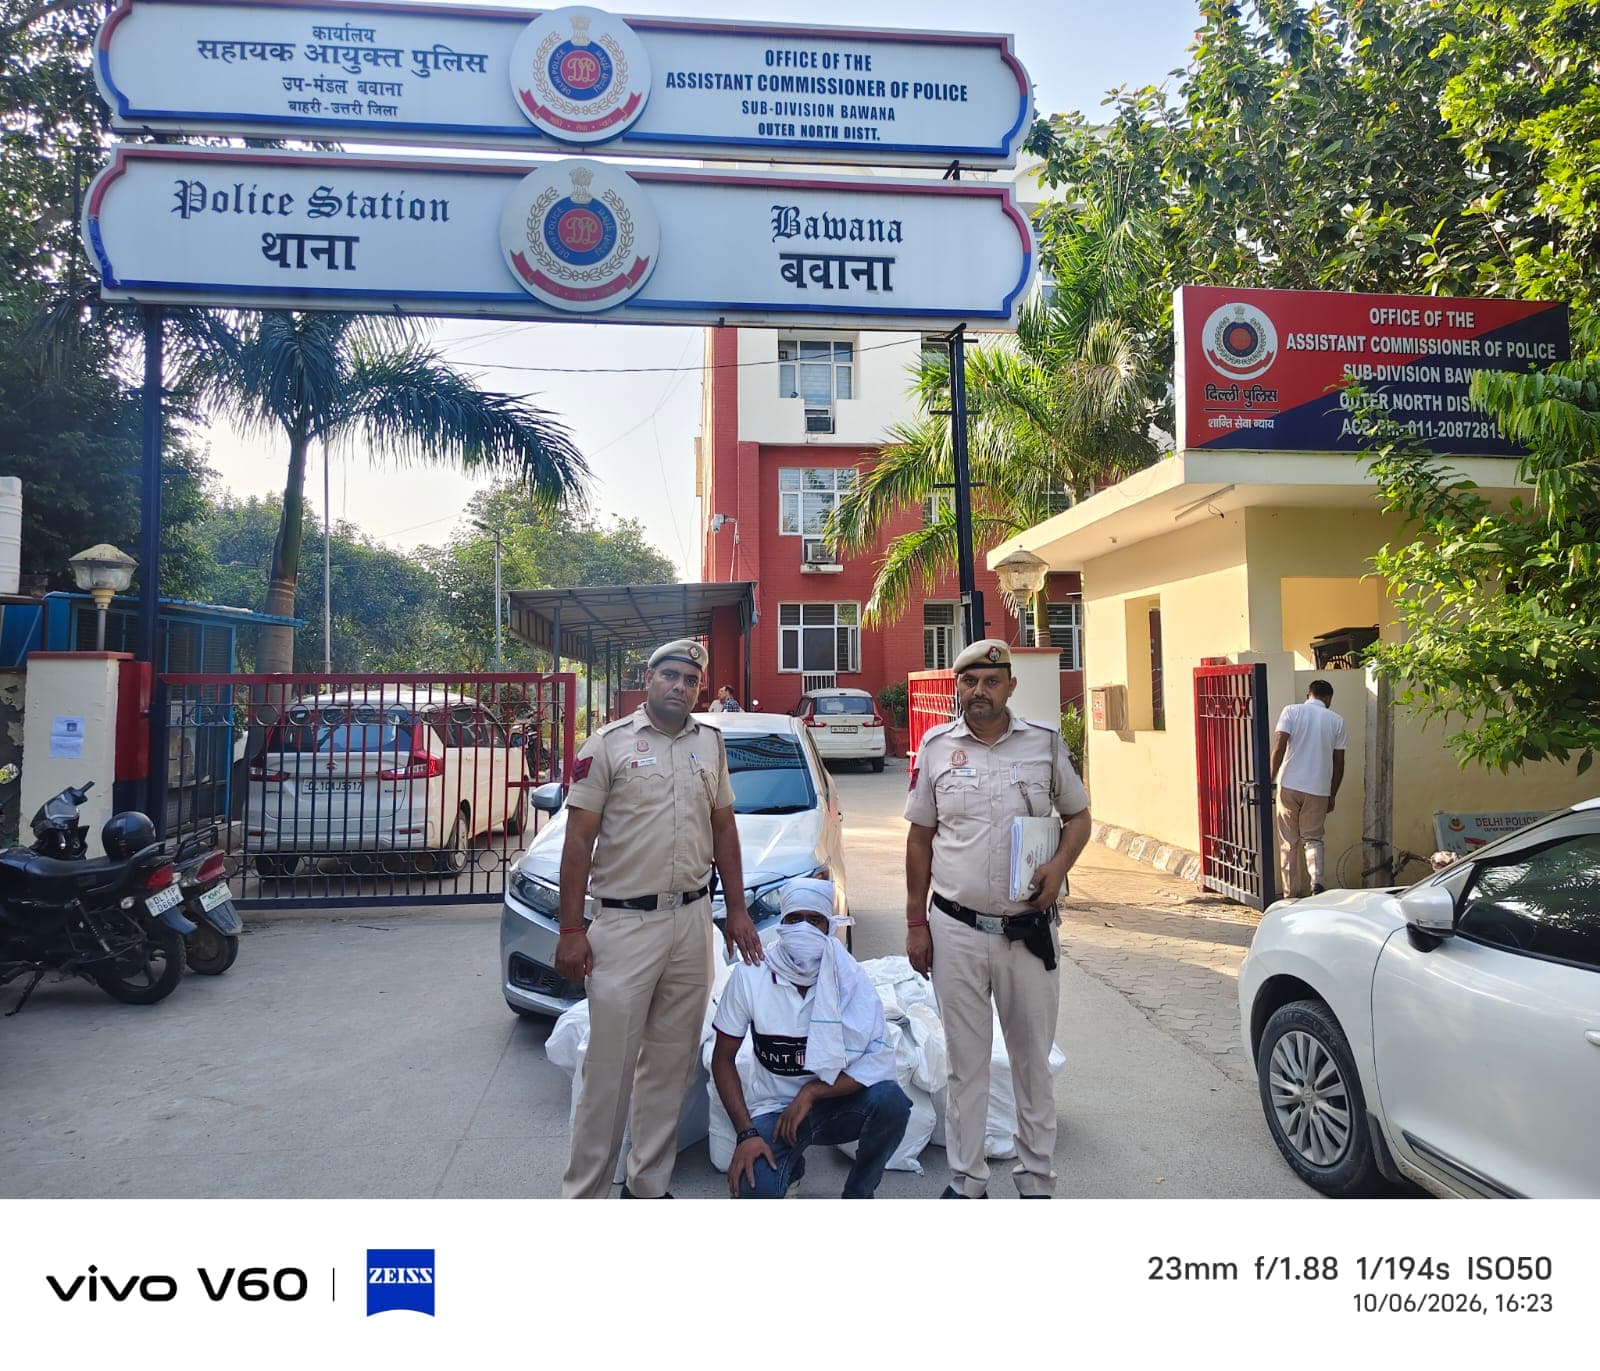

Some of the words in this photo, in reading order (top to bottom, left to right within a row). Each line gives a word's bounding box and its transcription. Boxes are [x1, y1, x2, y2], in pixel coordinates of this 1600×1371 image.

[312, 22, 376, 43] कार्यालय
[197, 39, 296, 64] सहायक
[304, 43, 404, 75] आयुक्त
[412, 44, 488, 78] पुलिस
[765, 49, 818, 69] OFFICE
[822, 52, 840, 69] OF
[844, 54, 872, 72] THE
[282, 74, 348, 95] उप-मंडल
[357, 81, 403, 97] बवाना
[666, 72, 754, 91] ASSISTANT
[757, 75, 886, 98] COMMISSIONER
[890, 81, 909, 98] OF
[913, 83, 968, 102] POLICE
[368, 100, 398, 117] जिला
[742, 100, 834, 118] SUB-DIVISION
[840, 104, 896, 121] BAWANA
[758, 121, 795, 137] OUTER
[801, 123, 839, 139] NORTH
[844, 125, 881, 141] DISTT.
[171, 180, 294, 220] Police
[306, 186, 449, 223] Station
[771, 205, 903, 243] Bawana
[262, 233, 360, 271] थाना
[779, 252, 896, 292] बवाना
[1369, 307, 1420, 326] OFFICE
[1424, 310, 1443, 327] OF
[1446, 311, 1475, 328] THE
[1286, 333, 1366, 352] ASSISTANT
[1370, 336, 1480, 357] COMMISSIONER
[1485, 341, 1503, 357] OF
[1507, 342, 1556, 360] POLICE
[1343, 363, 1440, 384] SUB-DIVISION
[1445, 366, 1503, 385] BAW
[1205, 383, 1240, 402] दिल्ली
[1241, 385, 1279, 408] पुलिस
[1393, 393, 1442, 412] NORTH
[1208, 415, 1233, 428] शान्ति
[1235, 416, 1252, 429] सेवा
[1253, 419, 1275, 429] न्याय
[1475, 817, 1503, 827] DELHI
[1505, 816, 1538, 826] POLICE
[757, 1046, 790, 1064] ANT
